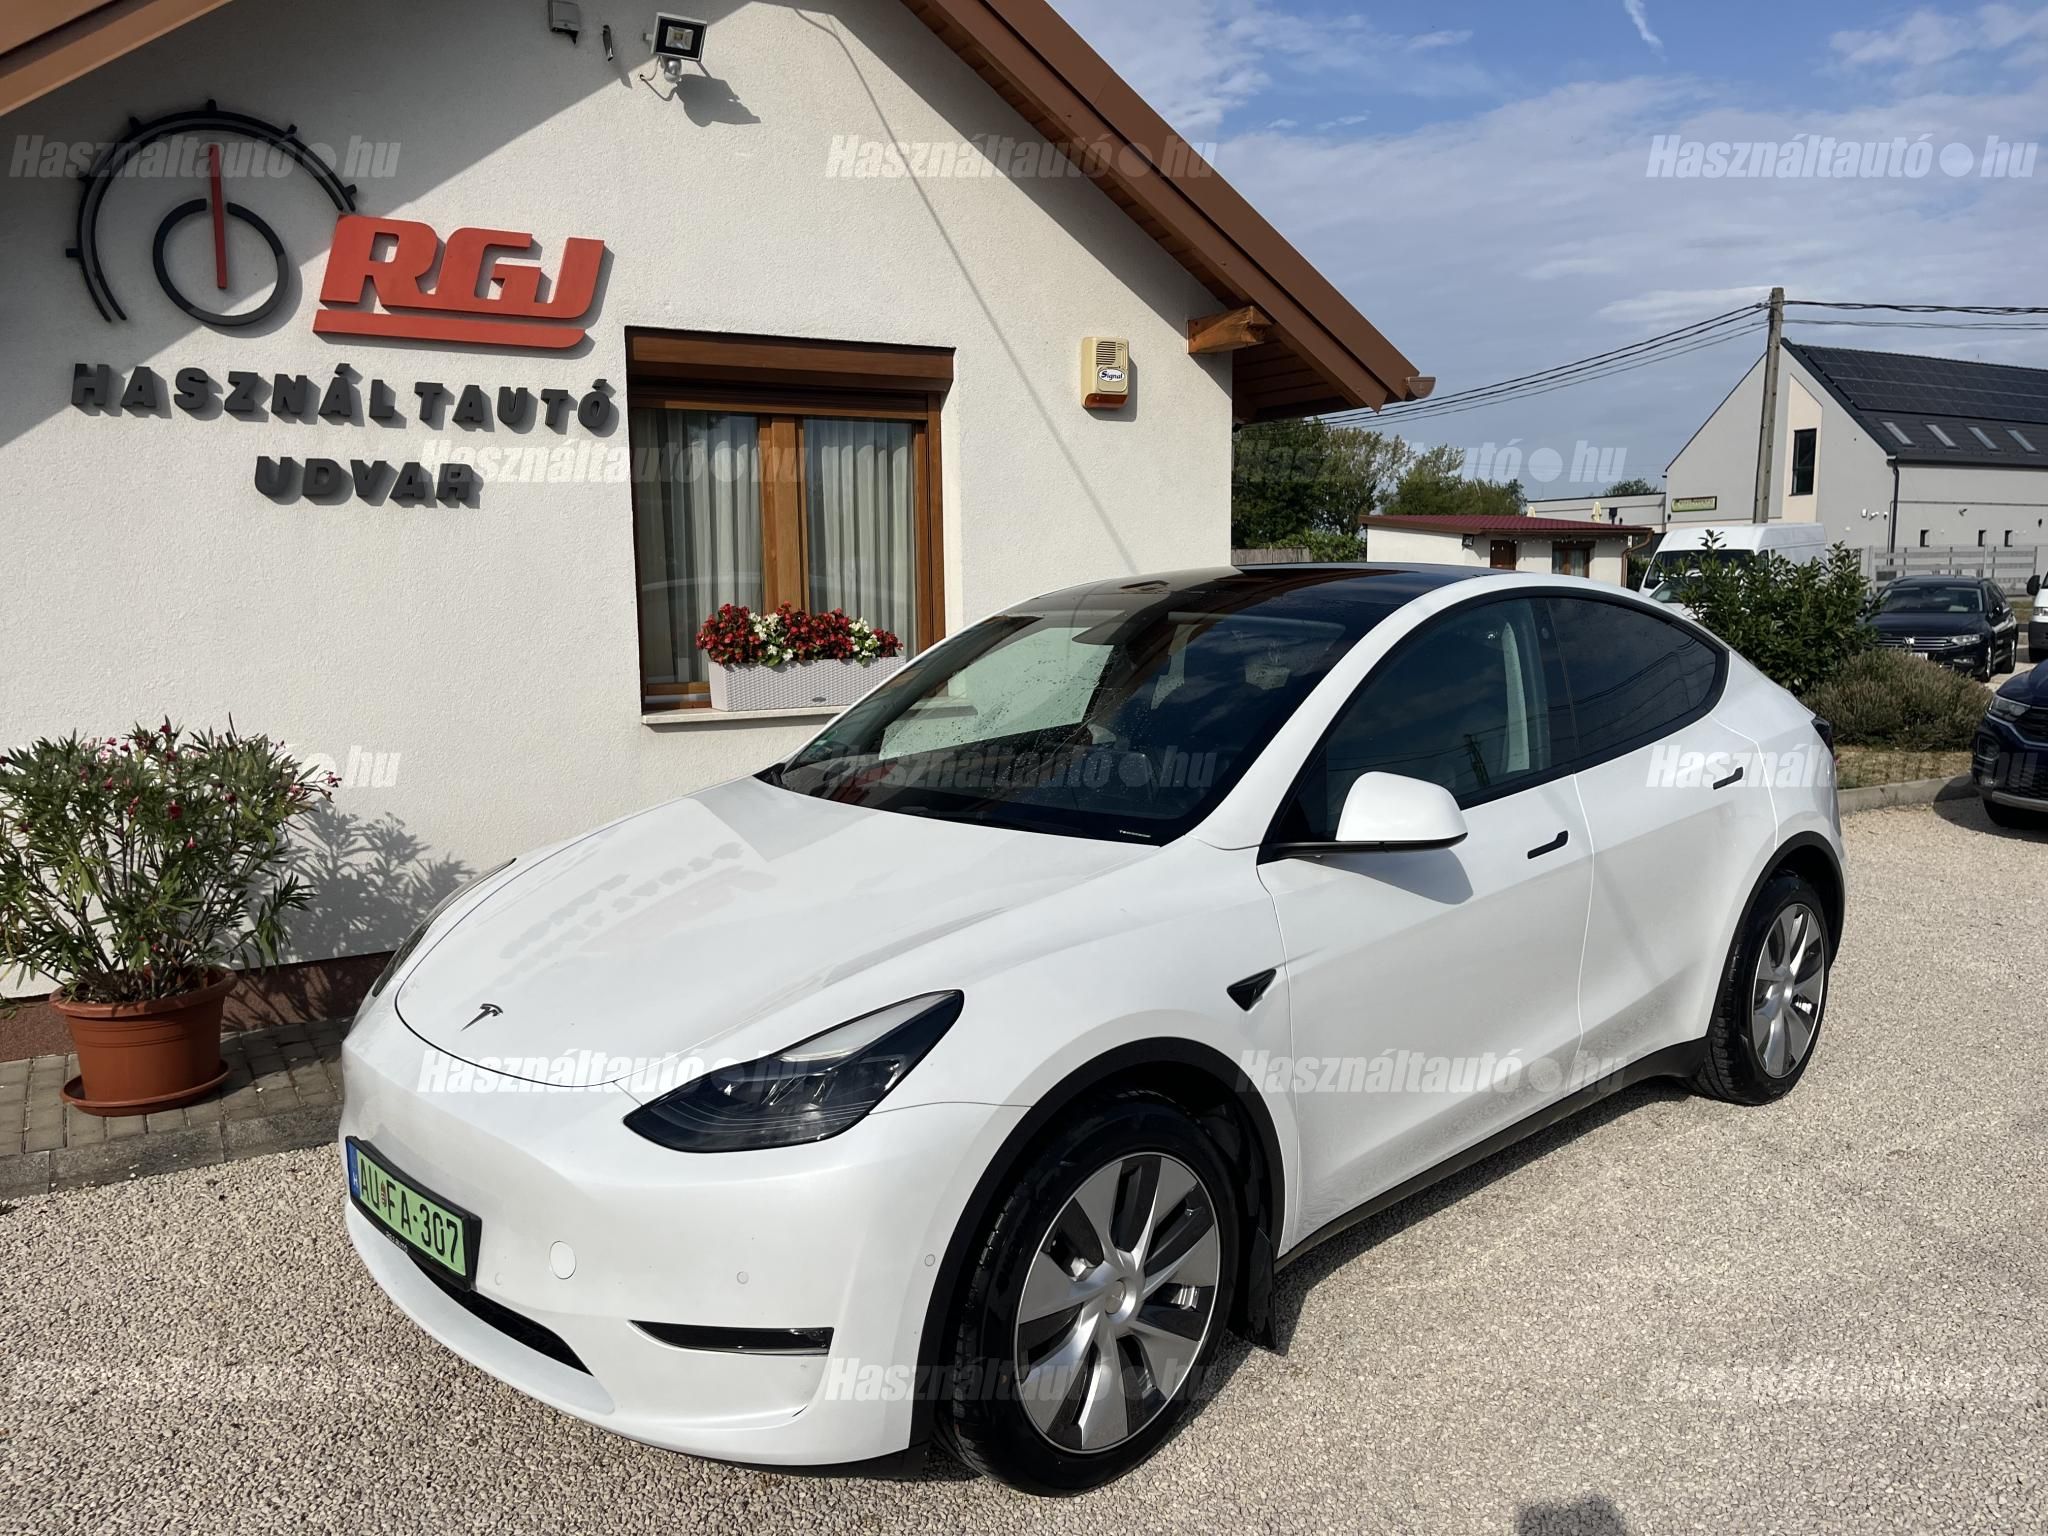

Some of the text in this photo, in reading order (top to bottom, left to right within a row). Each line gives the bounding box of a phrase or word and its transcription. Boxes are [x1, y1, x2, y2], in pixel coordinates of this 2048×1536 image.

[319, 214, 605, 319] RGJ
[1101, 370, 1123, 380] Signal
[254, 455, 477, 501] UDVAR
